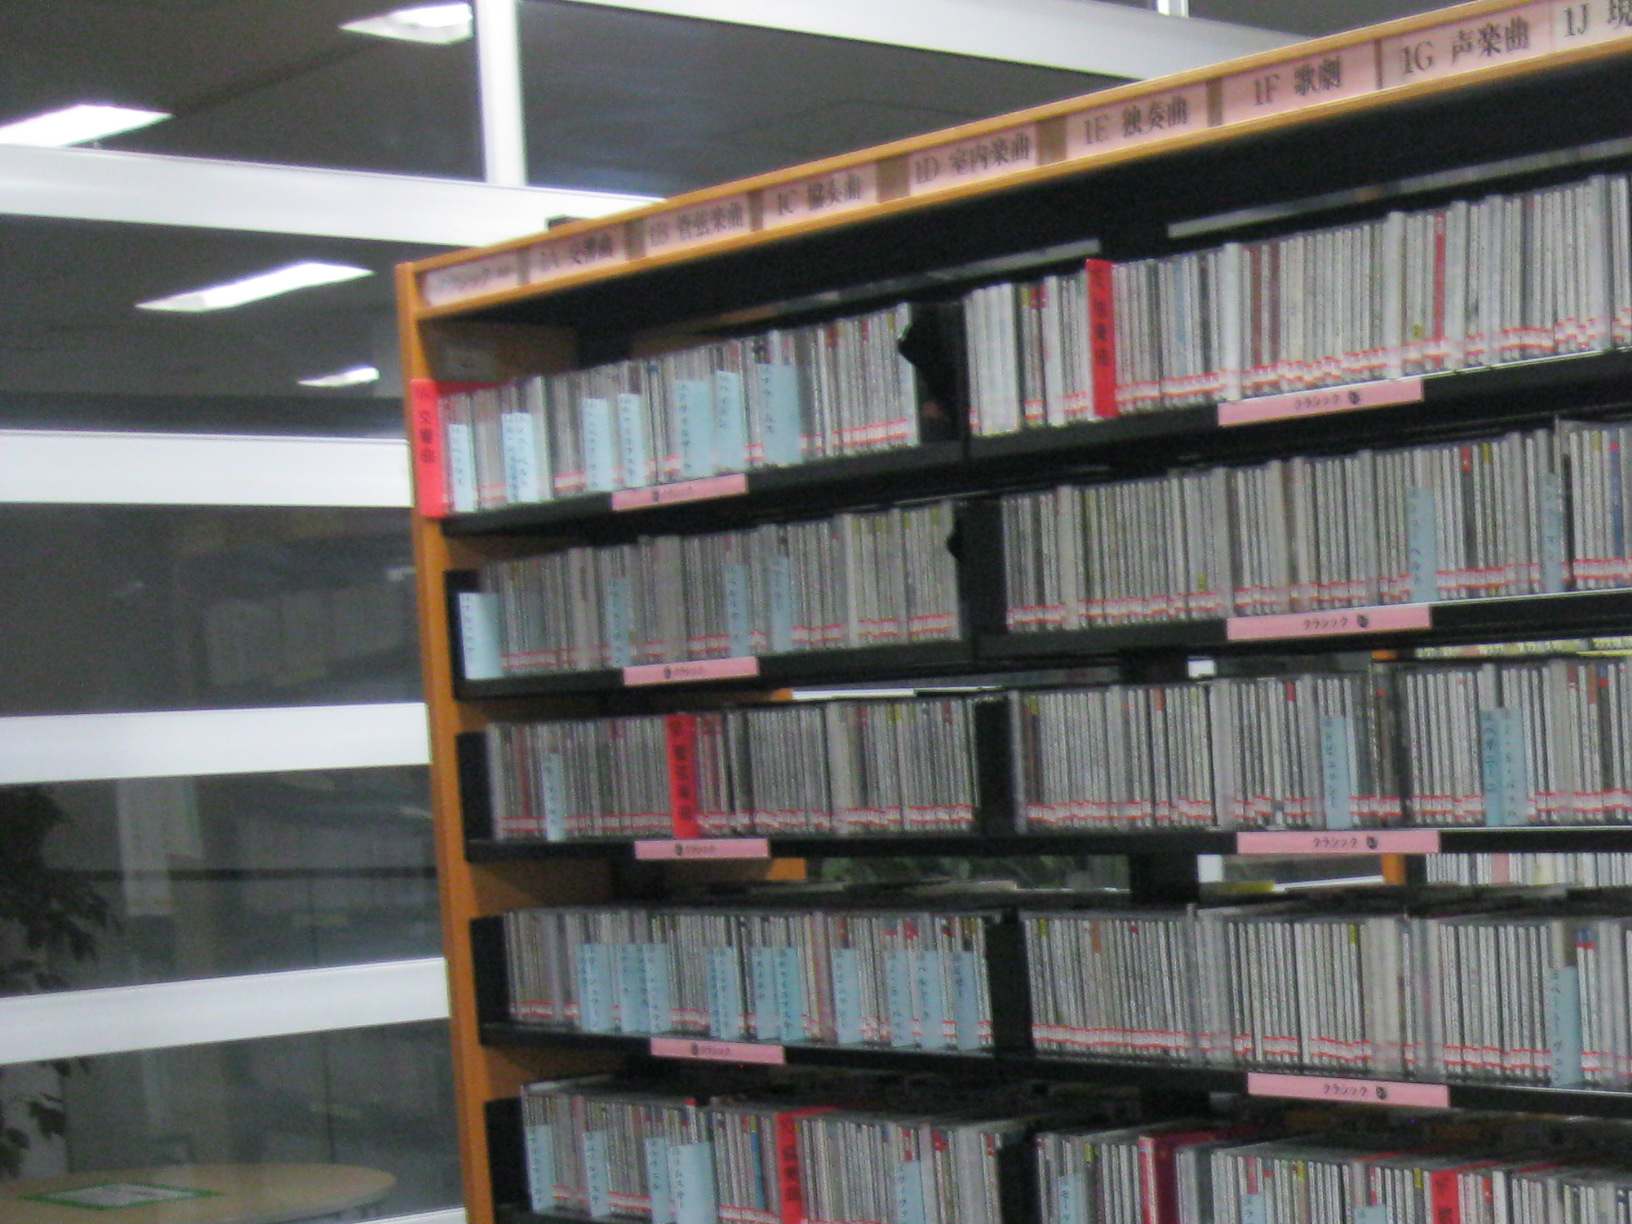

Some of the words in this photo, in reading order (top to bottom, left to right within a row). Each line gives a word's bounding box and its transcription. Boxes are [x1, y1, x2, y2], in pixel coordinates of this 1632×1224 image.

[1401, 41, 1434, 75] 1G
[1451, 16, 1530, 66] 声楽曲
